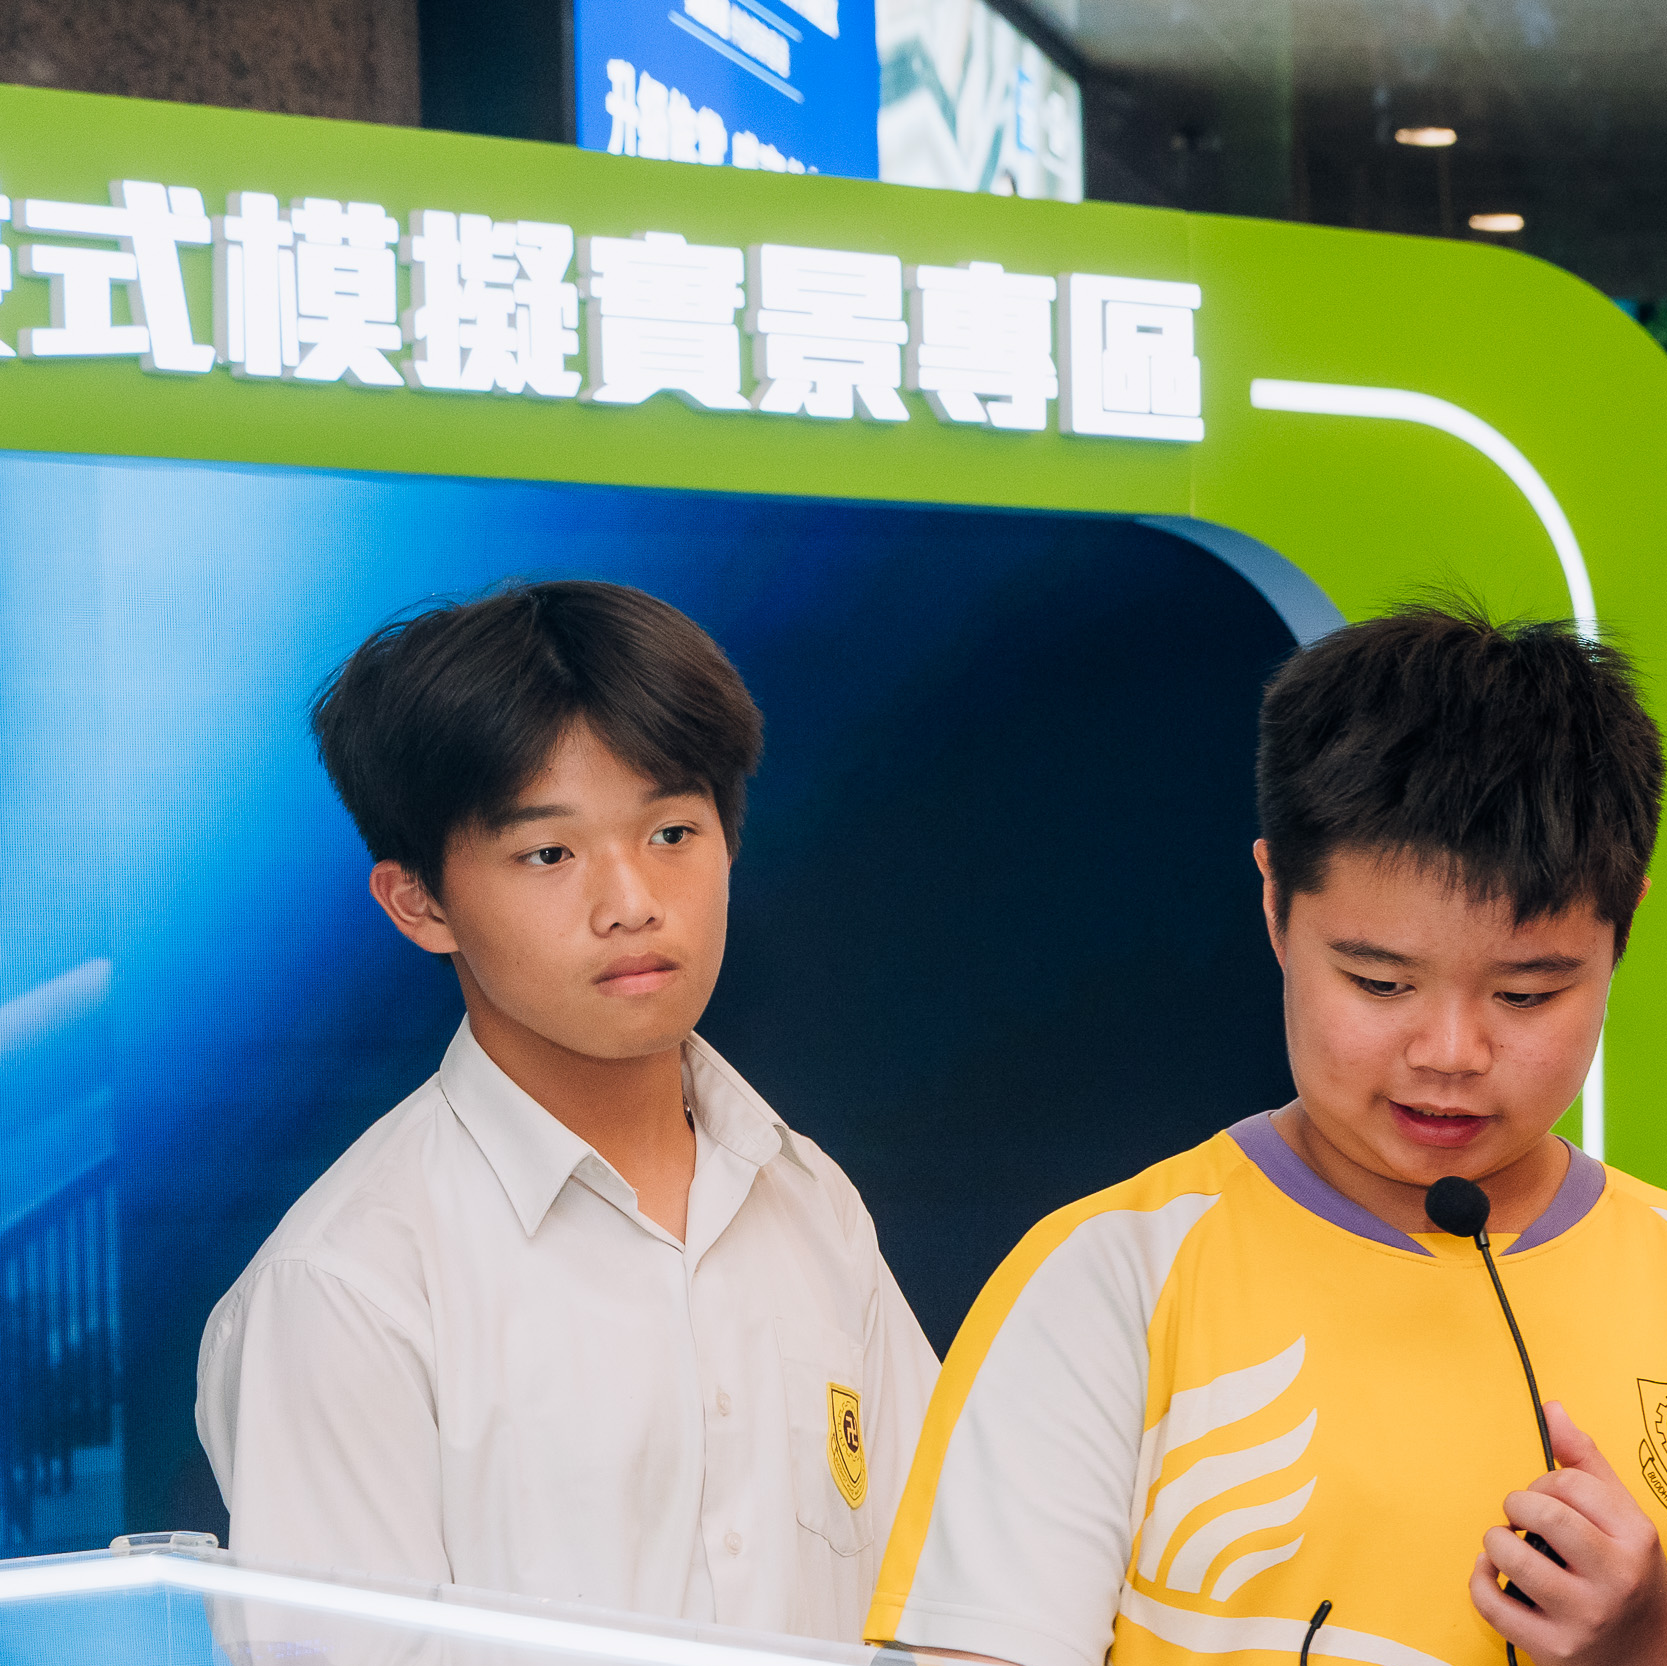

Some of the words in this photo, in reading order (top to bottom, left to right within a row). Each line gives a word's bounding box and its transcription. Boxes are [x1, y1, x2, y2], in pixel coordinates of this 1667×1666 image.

[0, 180, 1205, 442] 式模擬實景專區
